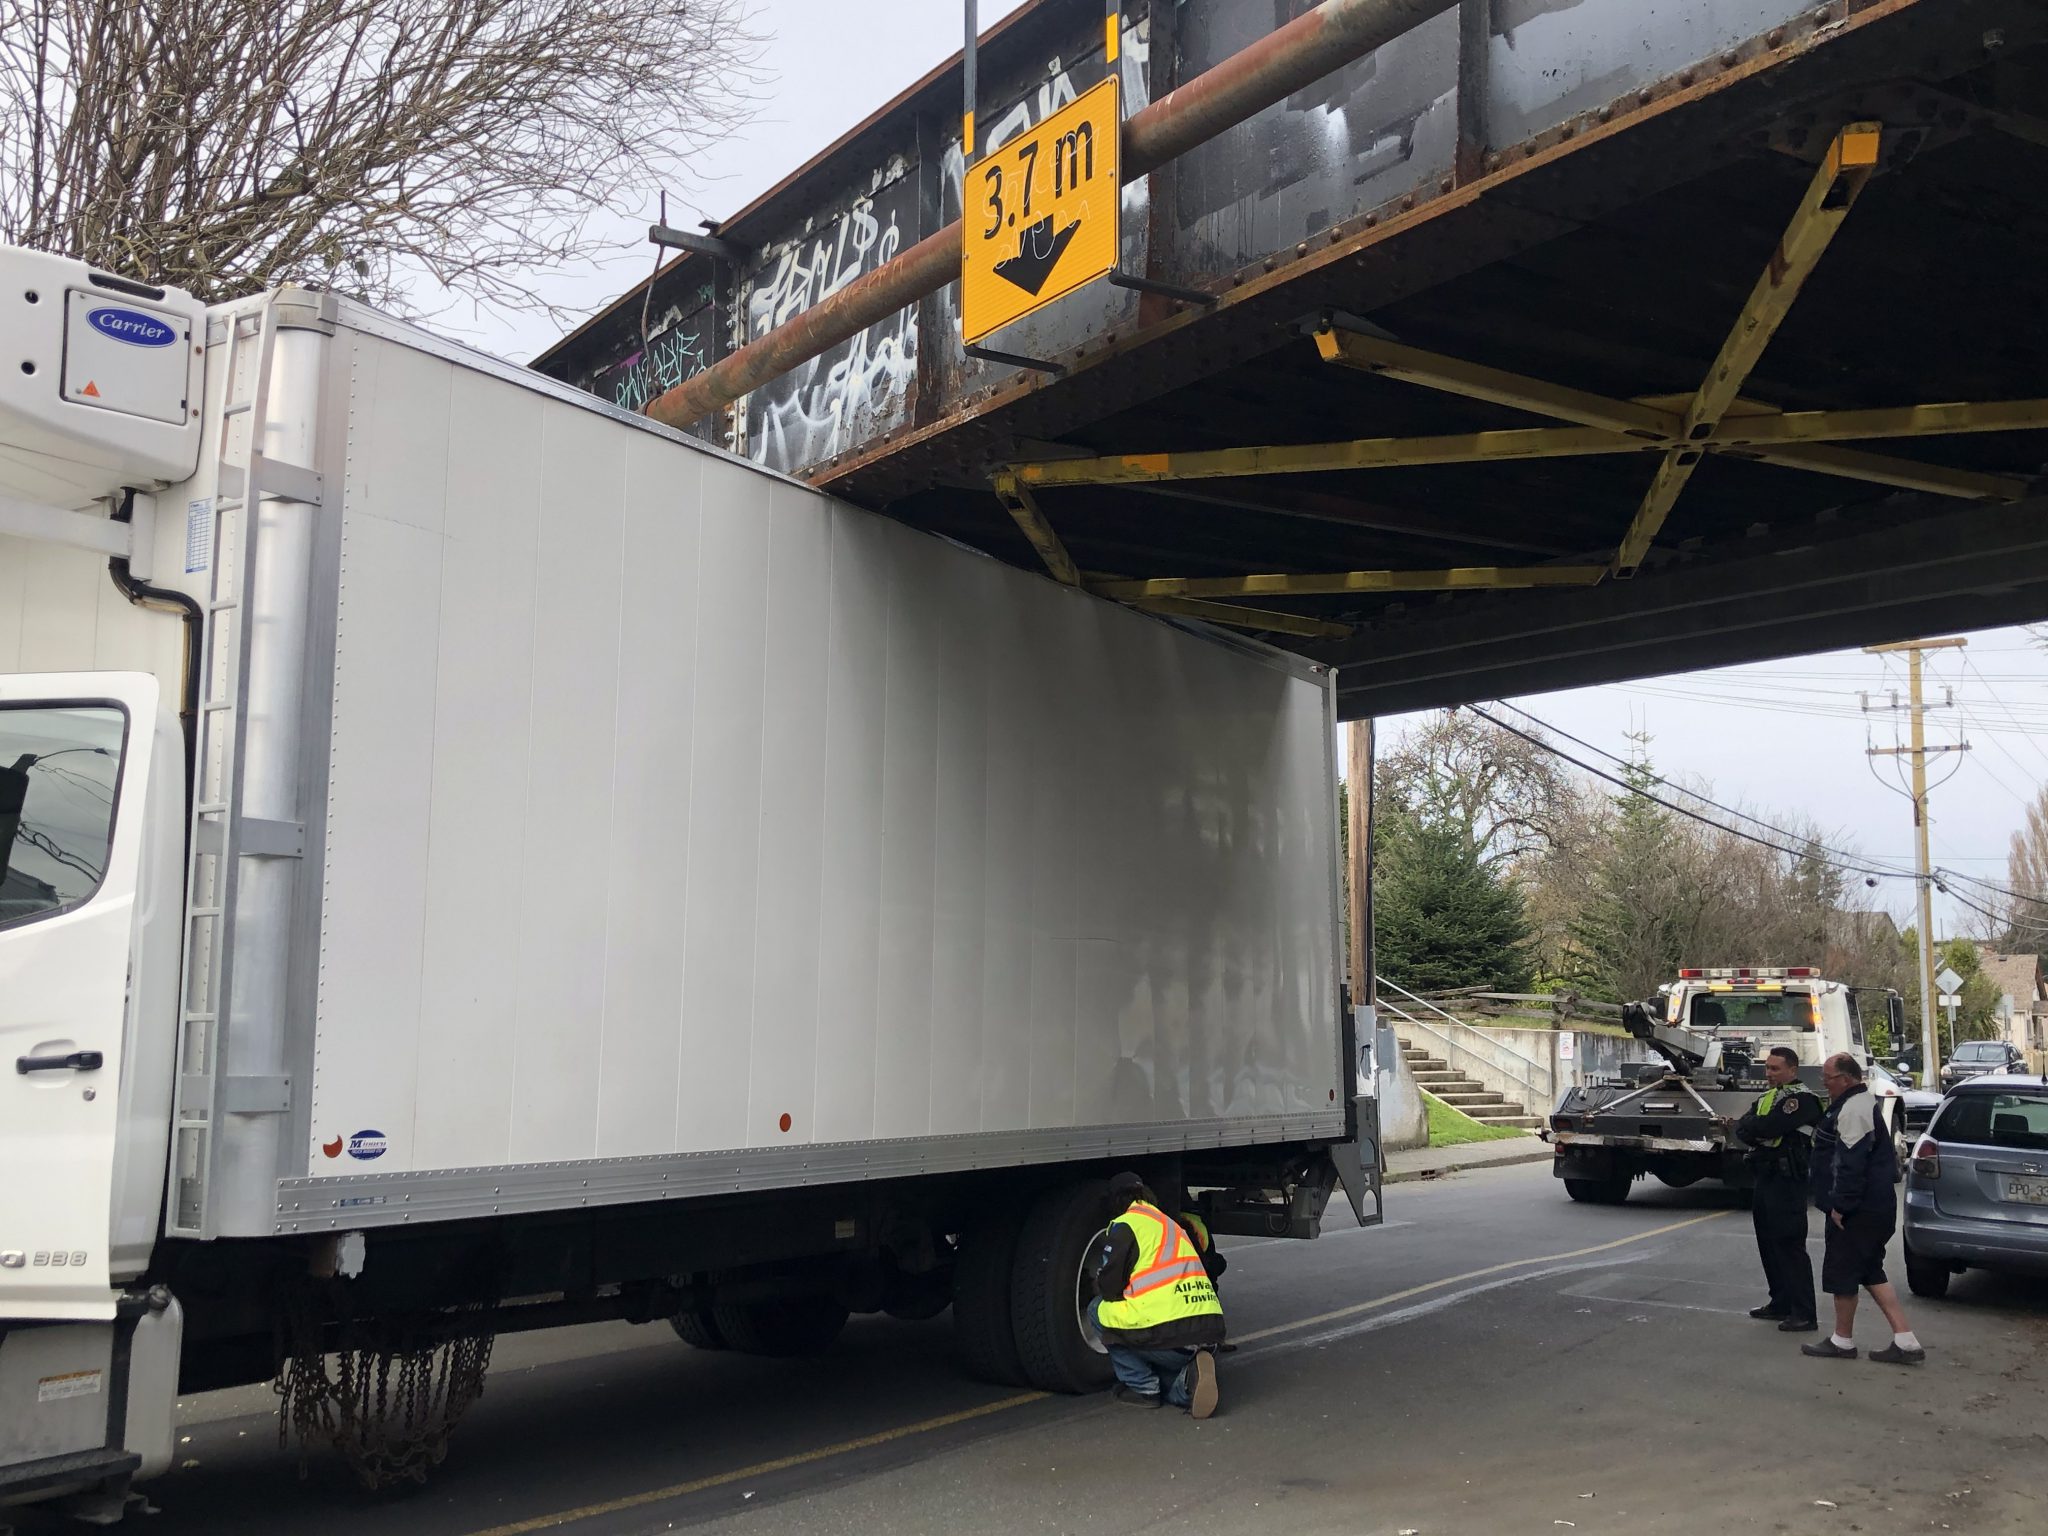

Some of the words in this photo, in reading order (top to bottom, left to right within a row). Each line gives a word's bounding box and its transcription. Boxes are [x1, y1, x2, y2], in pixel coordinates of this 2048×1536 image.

[984, 140, 1039, 240] 3.7
[1055, 120, 1093, 200] m
[99, 313, 166, 339] Carrier
[33, 1251, 87, 1267] 338
